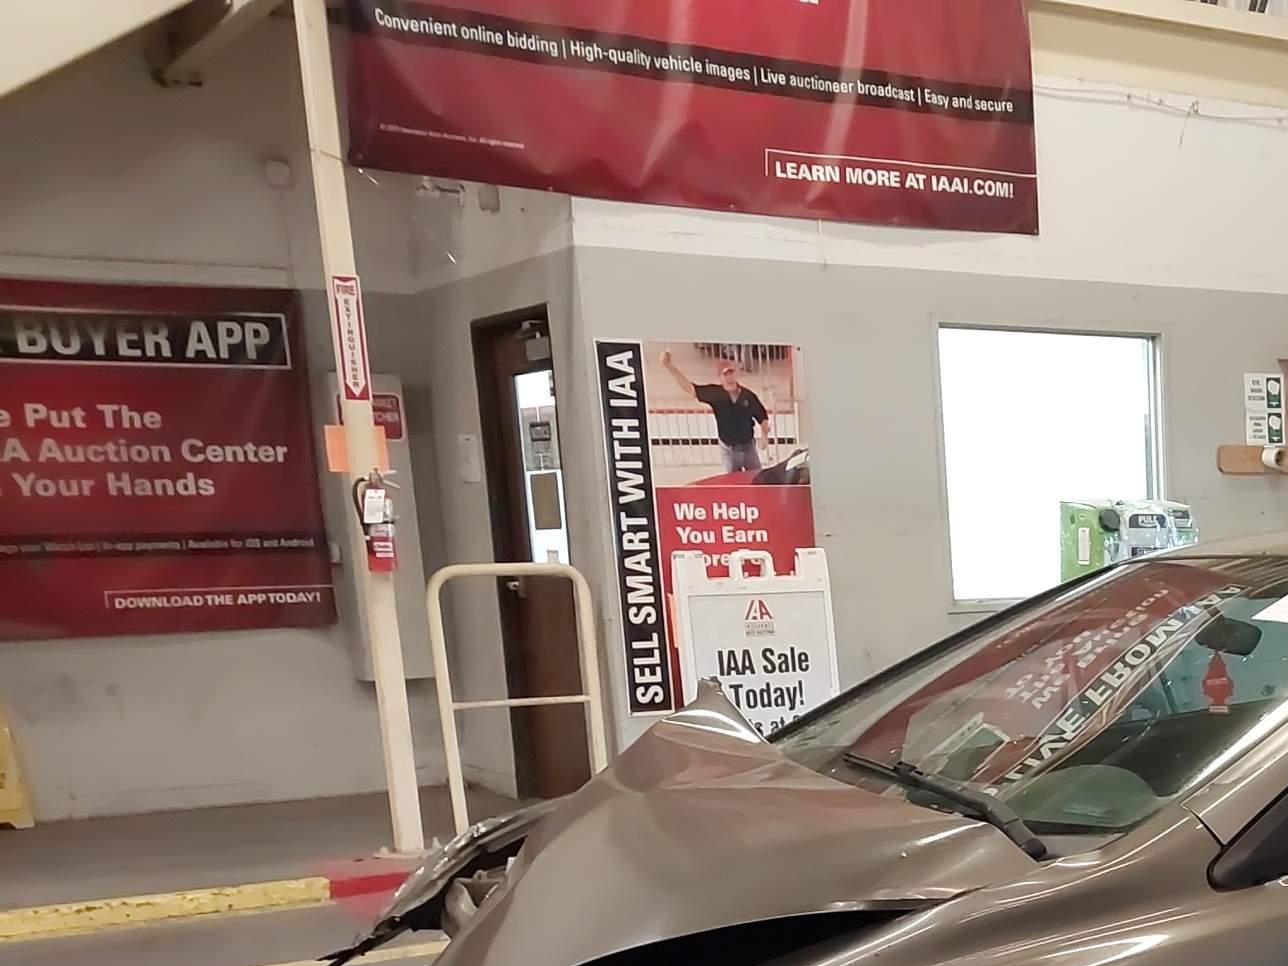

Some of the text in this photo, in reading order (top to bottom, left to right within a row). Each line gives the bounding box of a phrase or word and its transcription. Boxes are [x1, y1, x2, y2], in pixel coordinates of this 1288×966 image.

[374, 8, 458, 38] Convenient
[461, 25, 504, 45] online
[507, 30, 559, 57] bidding
[570, 40, 651, 70] High-quality
[653, 55, 702, 73] vehicle
[705, 59, 750, 81] images
[760, 68, 786, 86] Live
[789, 75, 853, 93] auctioneer
[857, 80, 916, 102] broadcast
[924, 89, 951, 109] Easy
[951, 96, 973, 109] and
[974, 99, 1014, 113] secure
[775, 161, 1014, 198] LEARN MORE AT IAAI.COM!
[15, 317, 272, 360] BUYER APP
[23, 403, 87, 428] Put
[96, 404, 162, 429] The
[38, 438, 172, 463] Auction
[181, 439, 289, 463] Center
[12, 472, 95, 497] Your
[106, 472, 216, 496] Hands
[607, 349, 664, 703] SELL SMART WITH IAA
[673, 502, 760, 523] We Help
[676, 525, 768, 544] You Earn
[114, 592, 321, 609] DOWNLOAD THE APP TODAY!
[717, 646, 810, 677] IAA Sale
[728, 679, 805, 712] Today!
